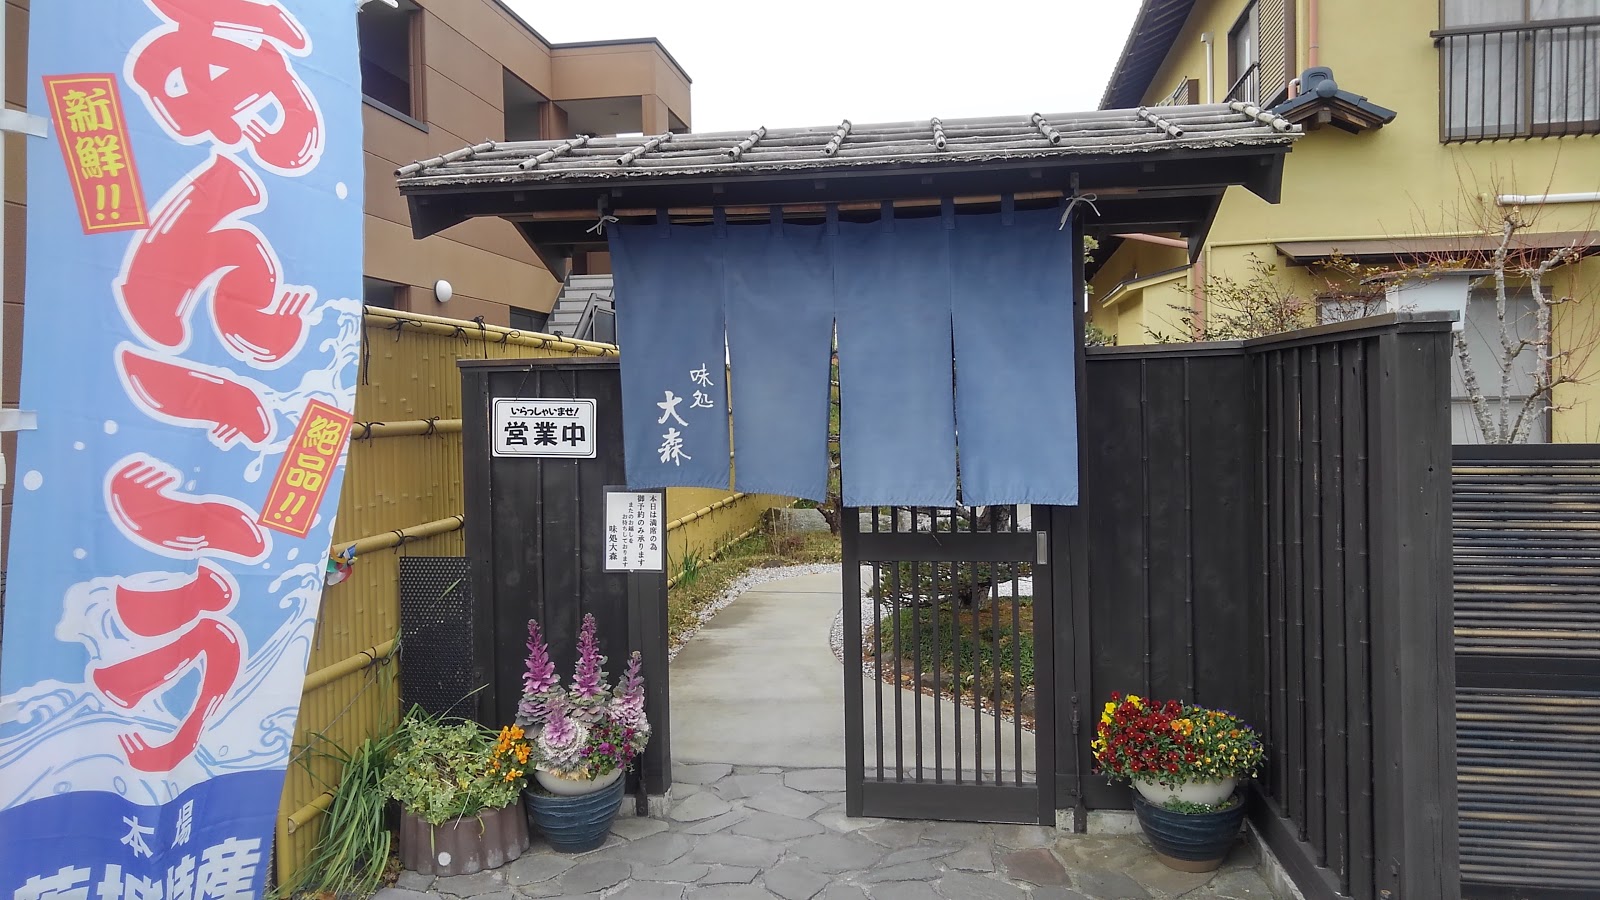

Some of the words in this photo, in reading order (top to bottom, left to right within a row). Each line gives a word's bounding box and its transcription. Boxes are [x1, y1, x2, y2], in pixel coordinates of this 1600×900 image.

[90, 0, 324, 773] あんこう
[689, 362, 715, 409] 味処
[503, 421, 587, 447] 営業中
[656, 390, 692, 467] 大森
[608, 524, 618, 561] 味処大森
[637, 494, 646, 567] 御予約のみ承ります
[649, 494, 658, 552] 本日は満席の為
[120, 799, 194, 859] 本場
